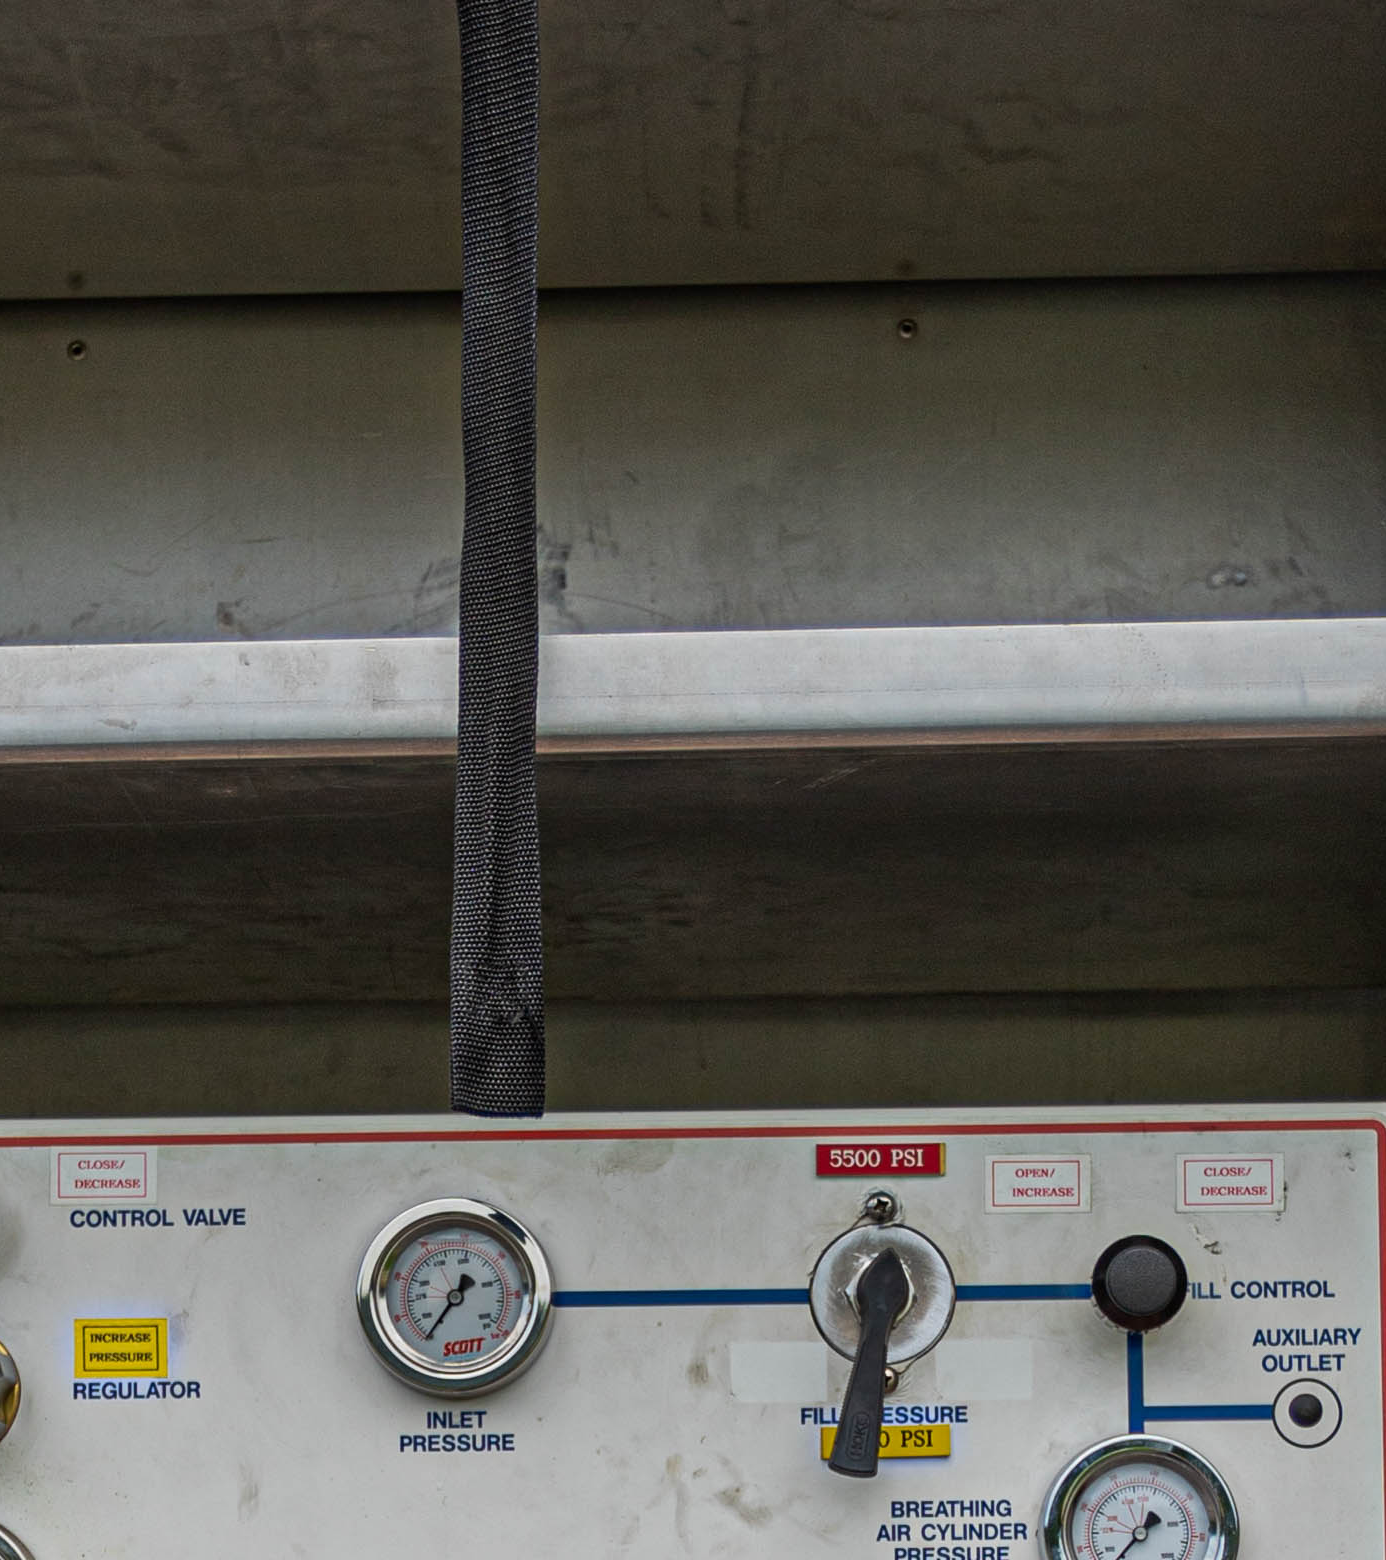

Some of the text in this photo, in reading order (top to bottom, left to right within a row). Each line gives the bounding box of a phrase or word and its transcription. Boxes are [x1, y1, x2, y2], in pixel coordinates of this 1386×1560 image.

[78, 1160, 125, 1170] CLOSE/
[830, 1149, 923, 1167] 5500 PSI
[1015, 1168, 1055, 1178] OPEN/
[1204, 1167, 1252, 1177] CLOSE/
[75, 1179, 140, 1189] DECREASE
[1013, 1187, 1074, 1197] INCREASE
[1201, 1186, 1267, 1196] DECREASE
[70, 1208, 246, 1228] CONTROL VALVE
[1187, 1280, 1336, 1300] ILL CONTROL
[90, 1333, 151, 1343] INCREASE
[1253, 1328, 1361, 1346] AUXILIARY
[443, 1337, 486, 1356] SCOTT
[89, 1351, 154, 1363] PRESSURE
[1262, 1354, 1345, 1372] OUTLET
[73, 1381, 200, 1399] REGULATOR
[427, 1411, 487, 1428] INLET
[801, 1406, 968, 1425] FILL ESSURE
[400, 1434, 515, 1452] PRESSURE
[901, 1430, 933, 1447] PSI
[891, 1500, 1011, 1518] BREATHING
[877, 1523, 1027, 1541] AIR CYLINDER
